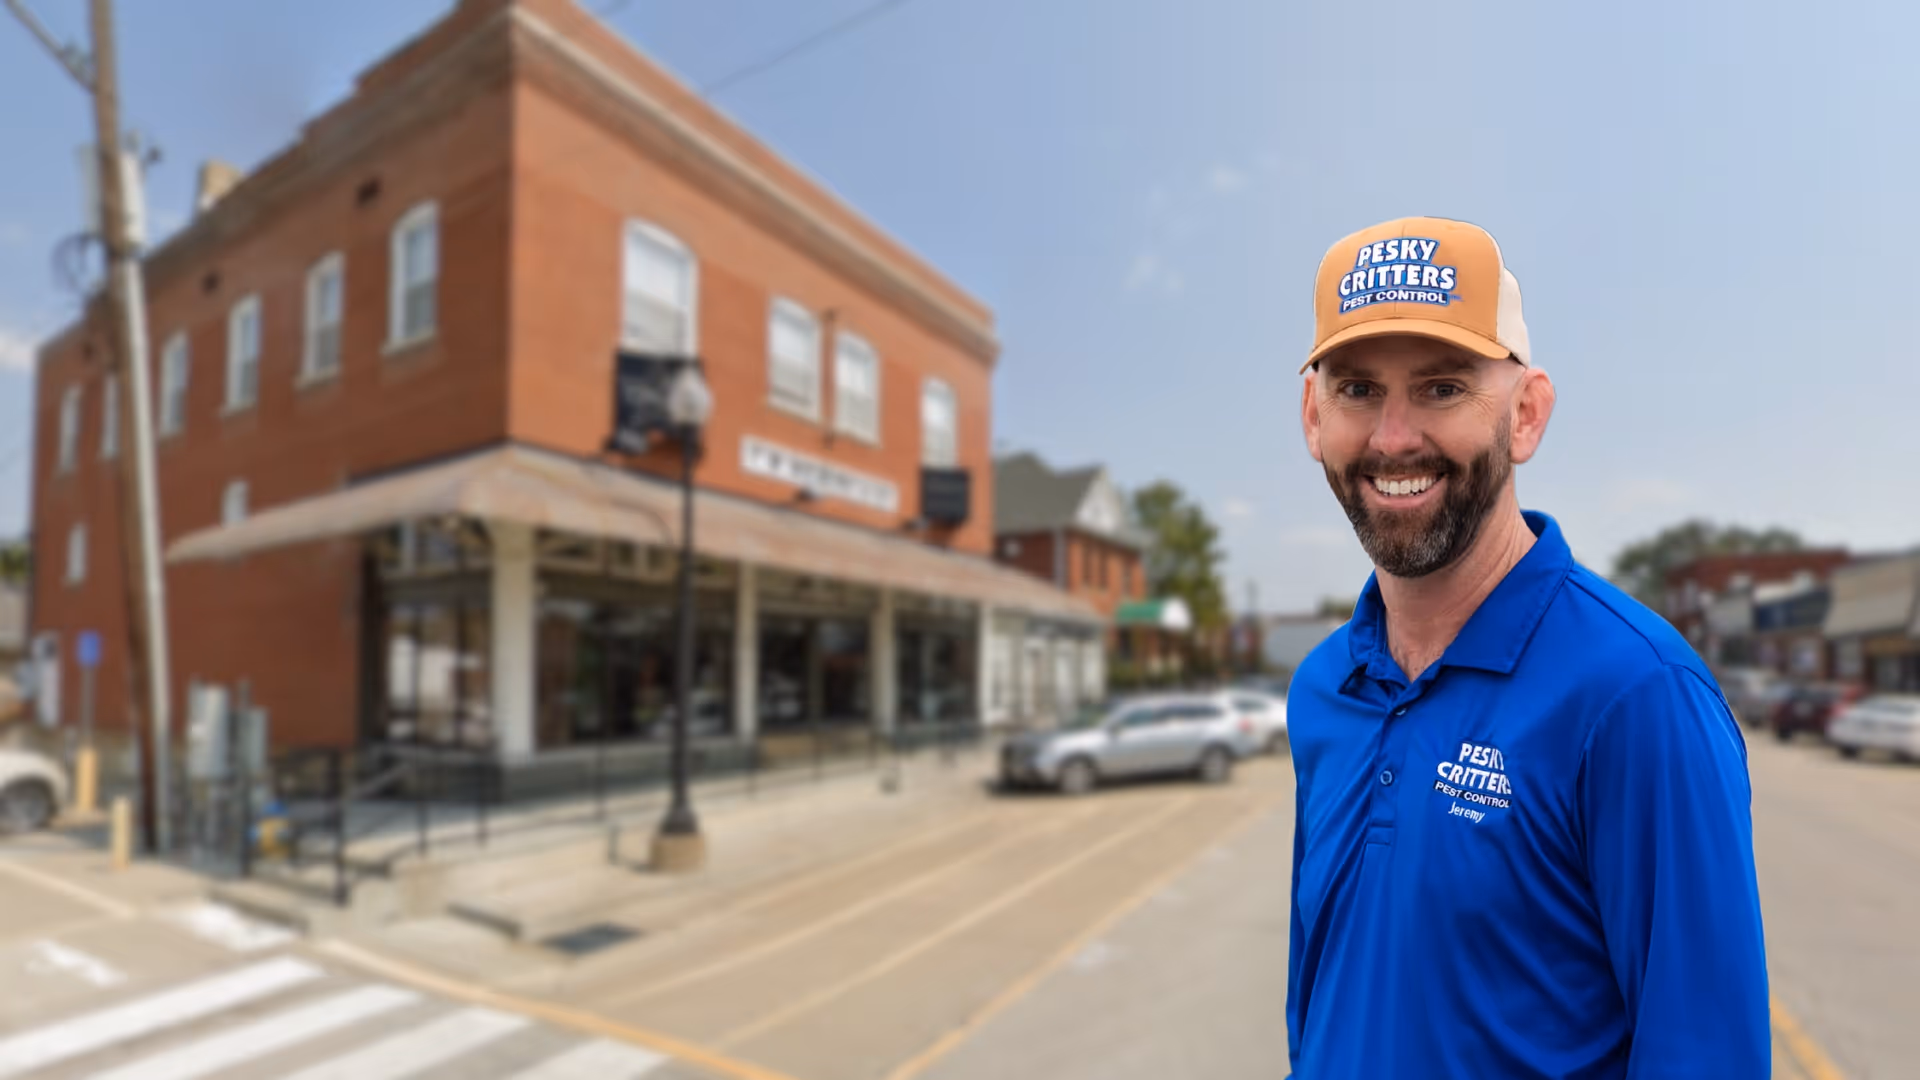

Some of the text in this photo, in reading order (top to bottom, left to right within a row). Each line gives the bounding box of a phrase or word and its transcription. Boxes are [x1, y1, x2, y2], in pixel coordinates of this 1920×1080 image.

[1357, 239, 1436, 267] PESKY
[1339, 264, 1456, 296] CRITTERS
[1343, 290, 1447, 312] PEST CONTROL
[1435, 781, 1510, 808] PEST CONTROL
[1448, 801, 1486, 824] Jeremy
